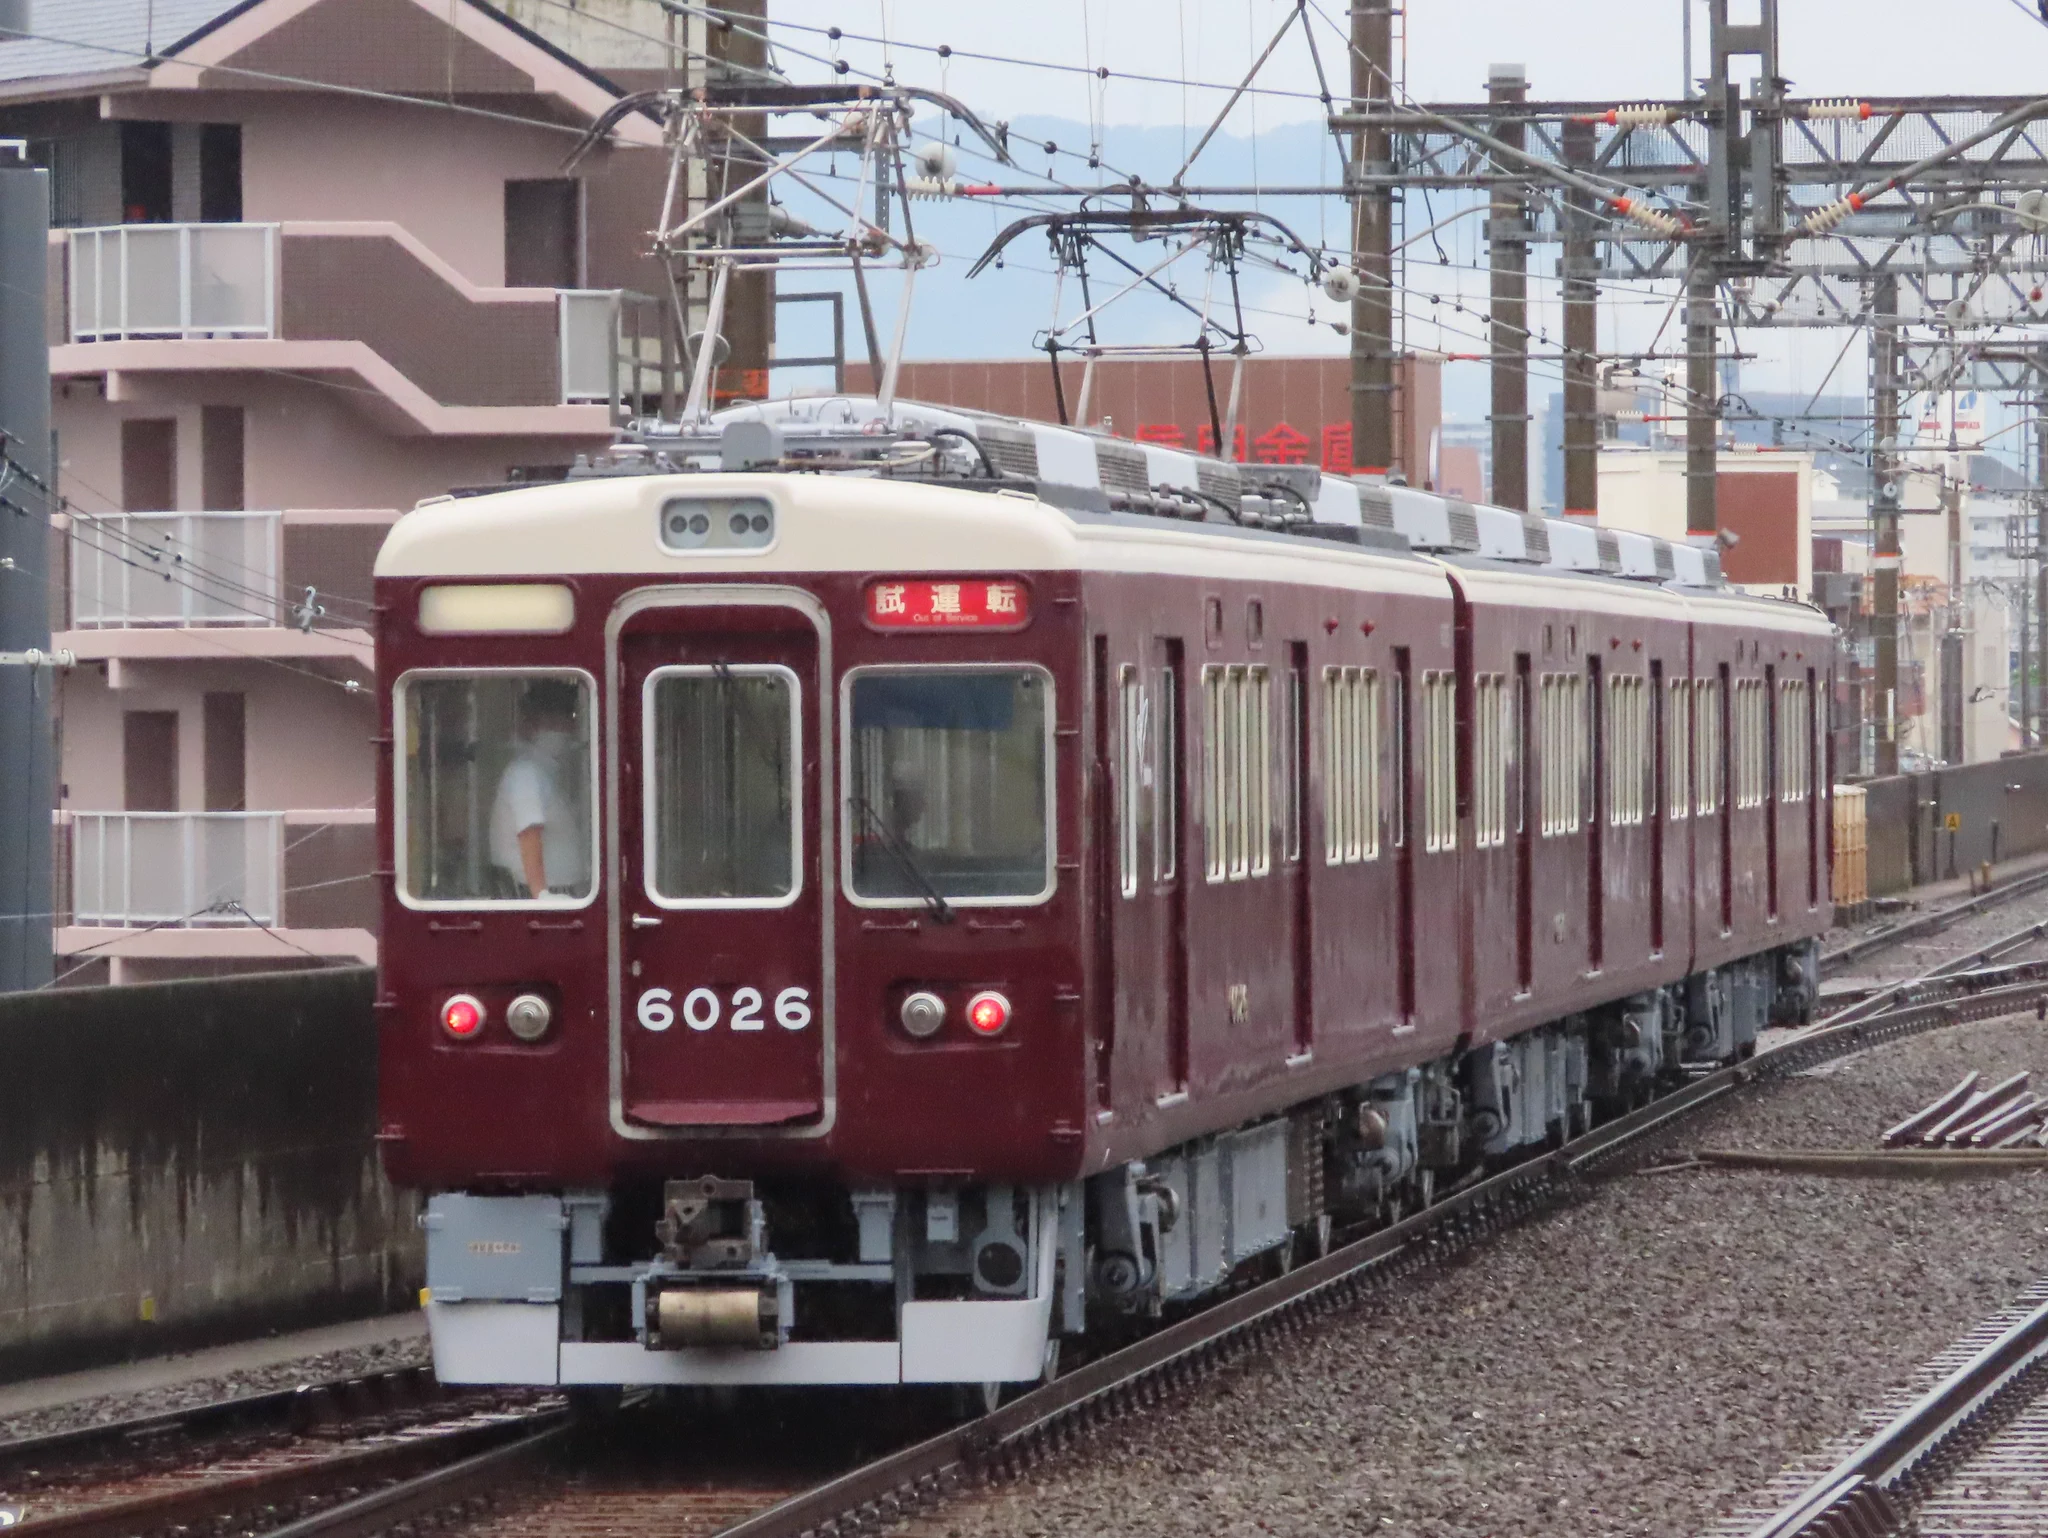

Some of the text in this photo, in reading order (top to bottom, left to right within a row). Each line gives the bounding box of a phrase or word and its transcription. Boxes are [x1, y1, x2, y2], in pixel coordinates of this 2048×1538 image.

[875, 583, 1017, 614] 試運転
[913, 613, 930, 622] Out
[946, 613, 979, 623] Service
[637, 986, 811, 1031] 6026
